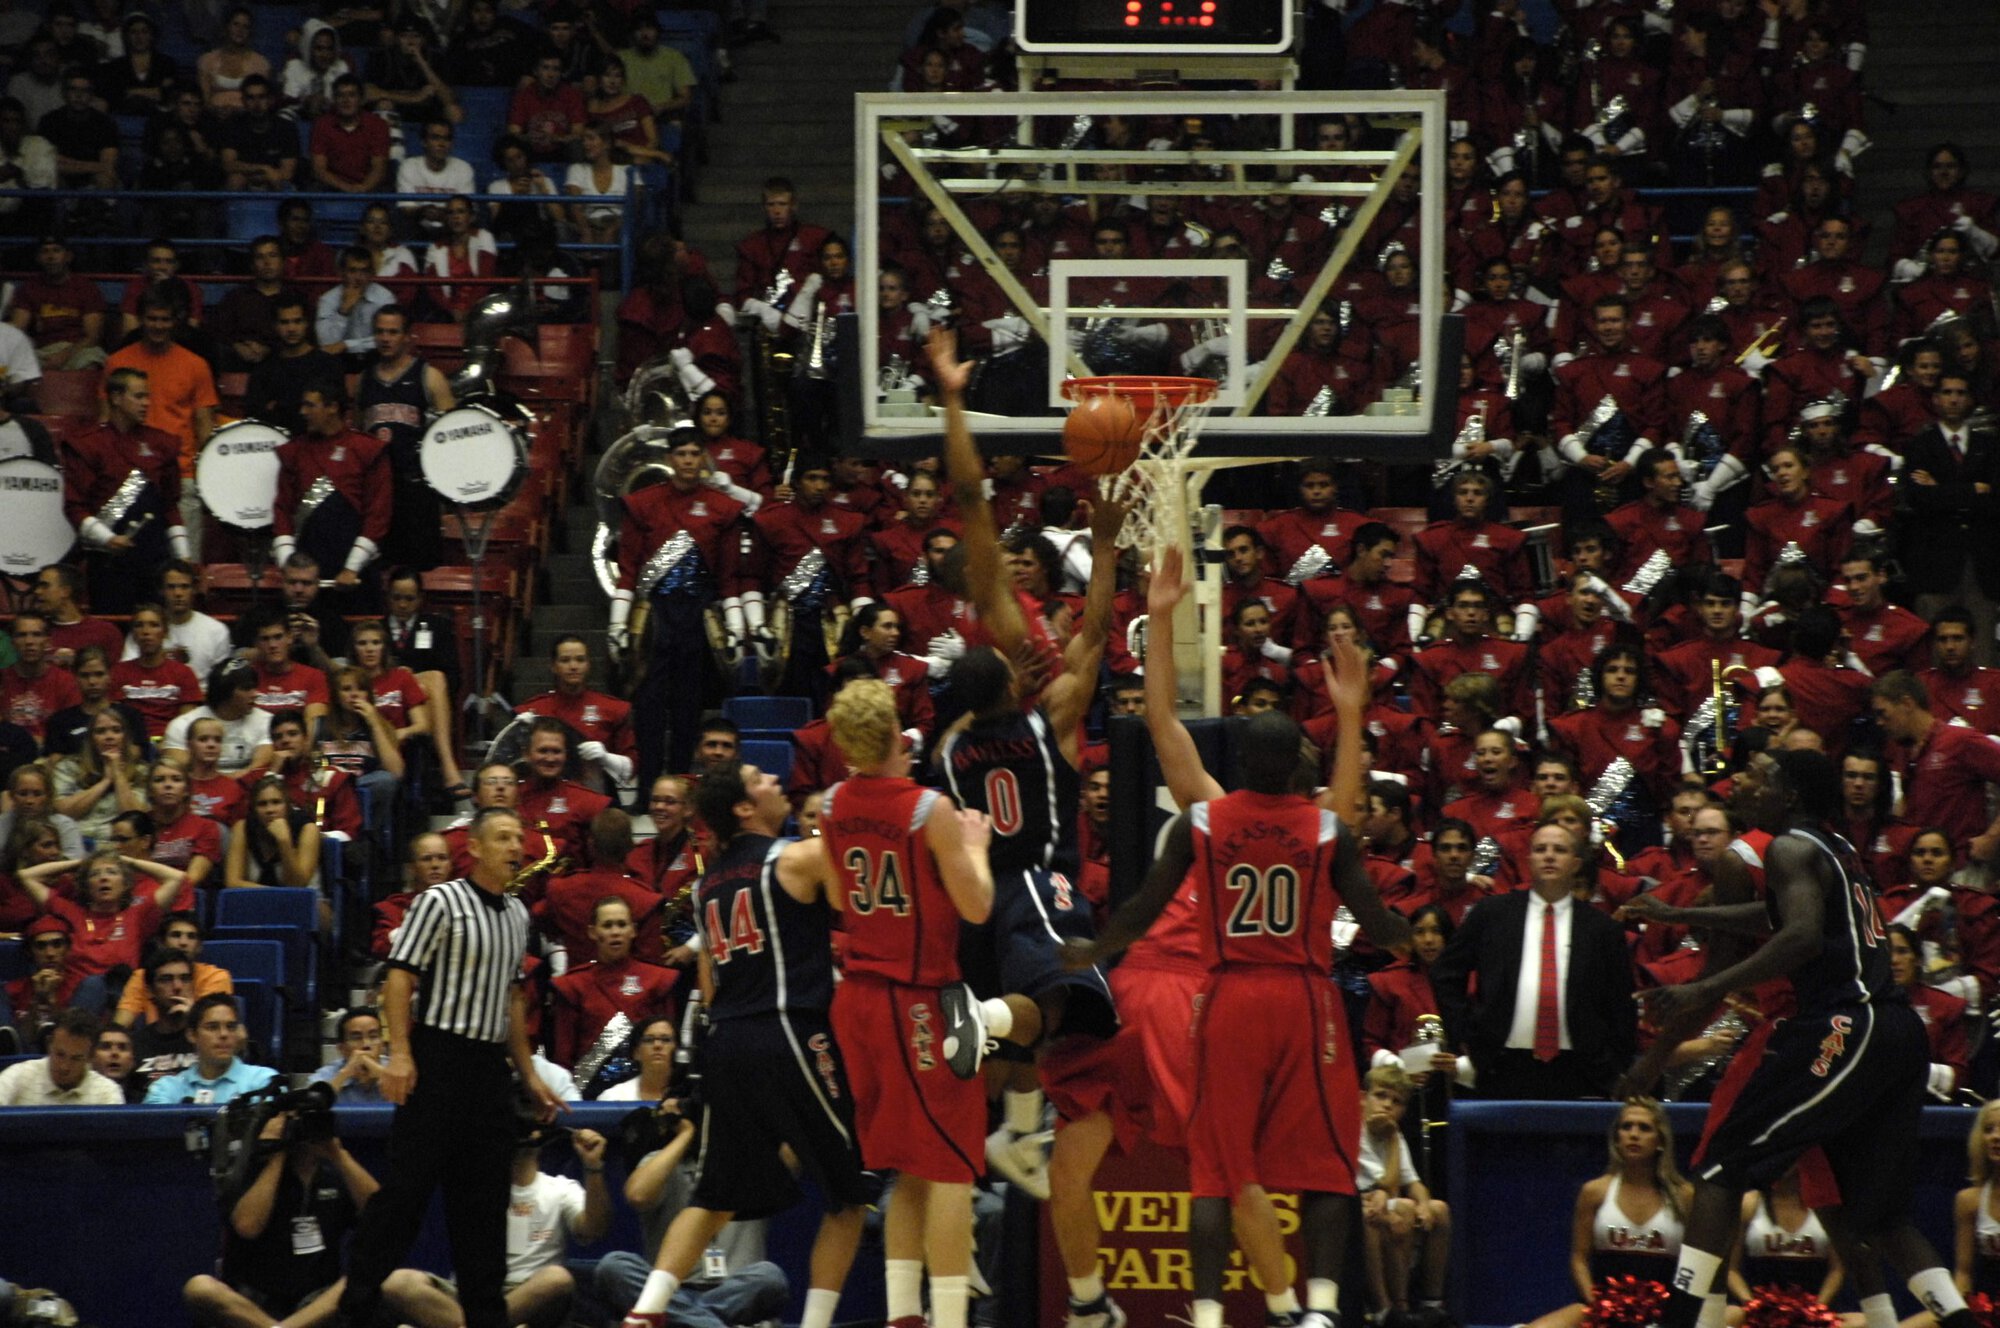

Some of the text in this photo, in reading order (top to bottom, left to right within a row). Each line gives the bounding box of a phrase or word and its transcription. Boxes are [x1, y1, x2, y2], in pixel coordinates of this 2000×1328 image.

[448, 423, 495, 441] YAMAHA
[4, 476, 59, 492] YAMAHA
[984, 767, 1024, 837] 0
[843, 846, 912, 917] 34
[1225, 863, 1301, 937] 20
[705, 886, 766, 965] 44
[1810, 1014, 1853, 1078] CATS
[1092, 1190, 1302, 1236] WES
